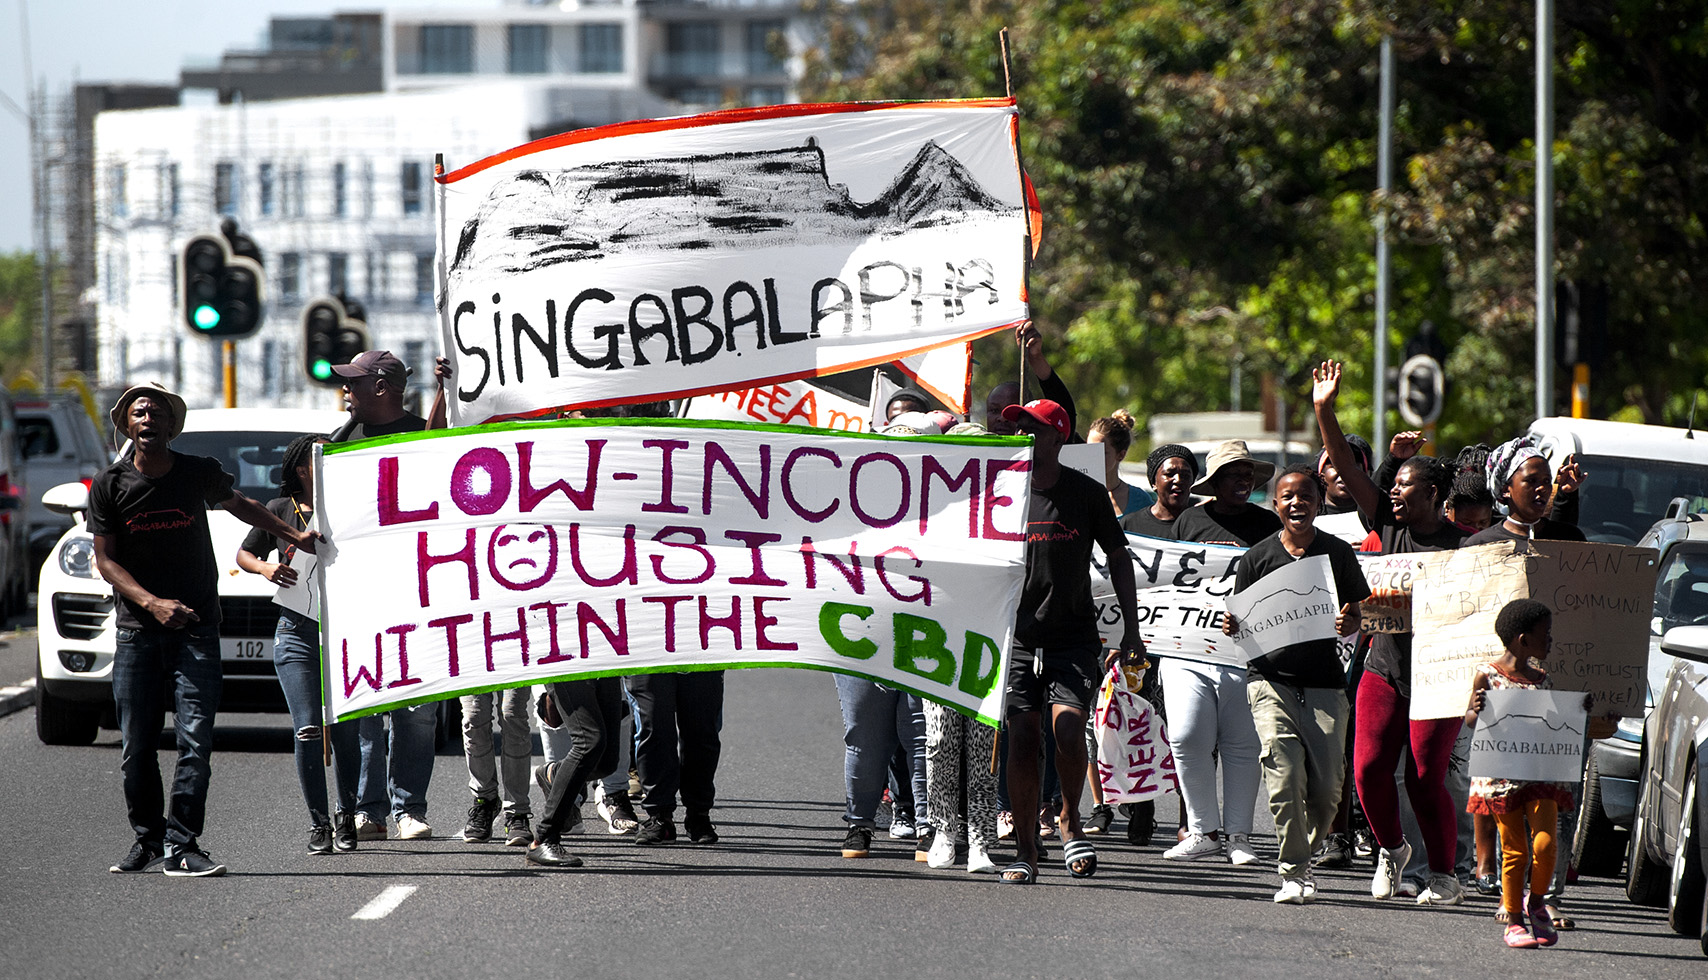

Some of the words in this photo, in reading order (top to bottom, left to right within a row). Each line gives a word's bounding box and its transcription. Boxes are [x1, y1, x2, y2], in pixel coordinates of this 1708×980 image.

[378, 439, 1032, 542] LOW-INCOME
[130, 520, 191, 532] SINGABALAPHA
[417, 522, 932, 607] HOUSING
[1469, 554, 1539, 586] ALSO
[1559, 549, 1652, 575] WANT
[1179, 606, 1225, 629] THE
[1232, 602, 1338, 643] SINGABALAPHA
[1360, 616, 1404, 633] GIVEN
[236, 641, 264, 658] 102
[819, 601, 1001, 699] CBD
[1556, 642, 1595, 656] STOP
[1083, 678, 1092, 689] 10
[1127, 708, 1159, 794] NEAR
[1472, 739, 1581, 755] SINGABALAPHA
